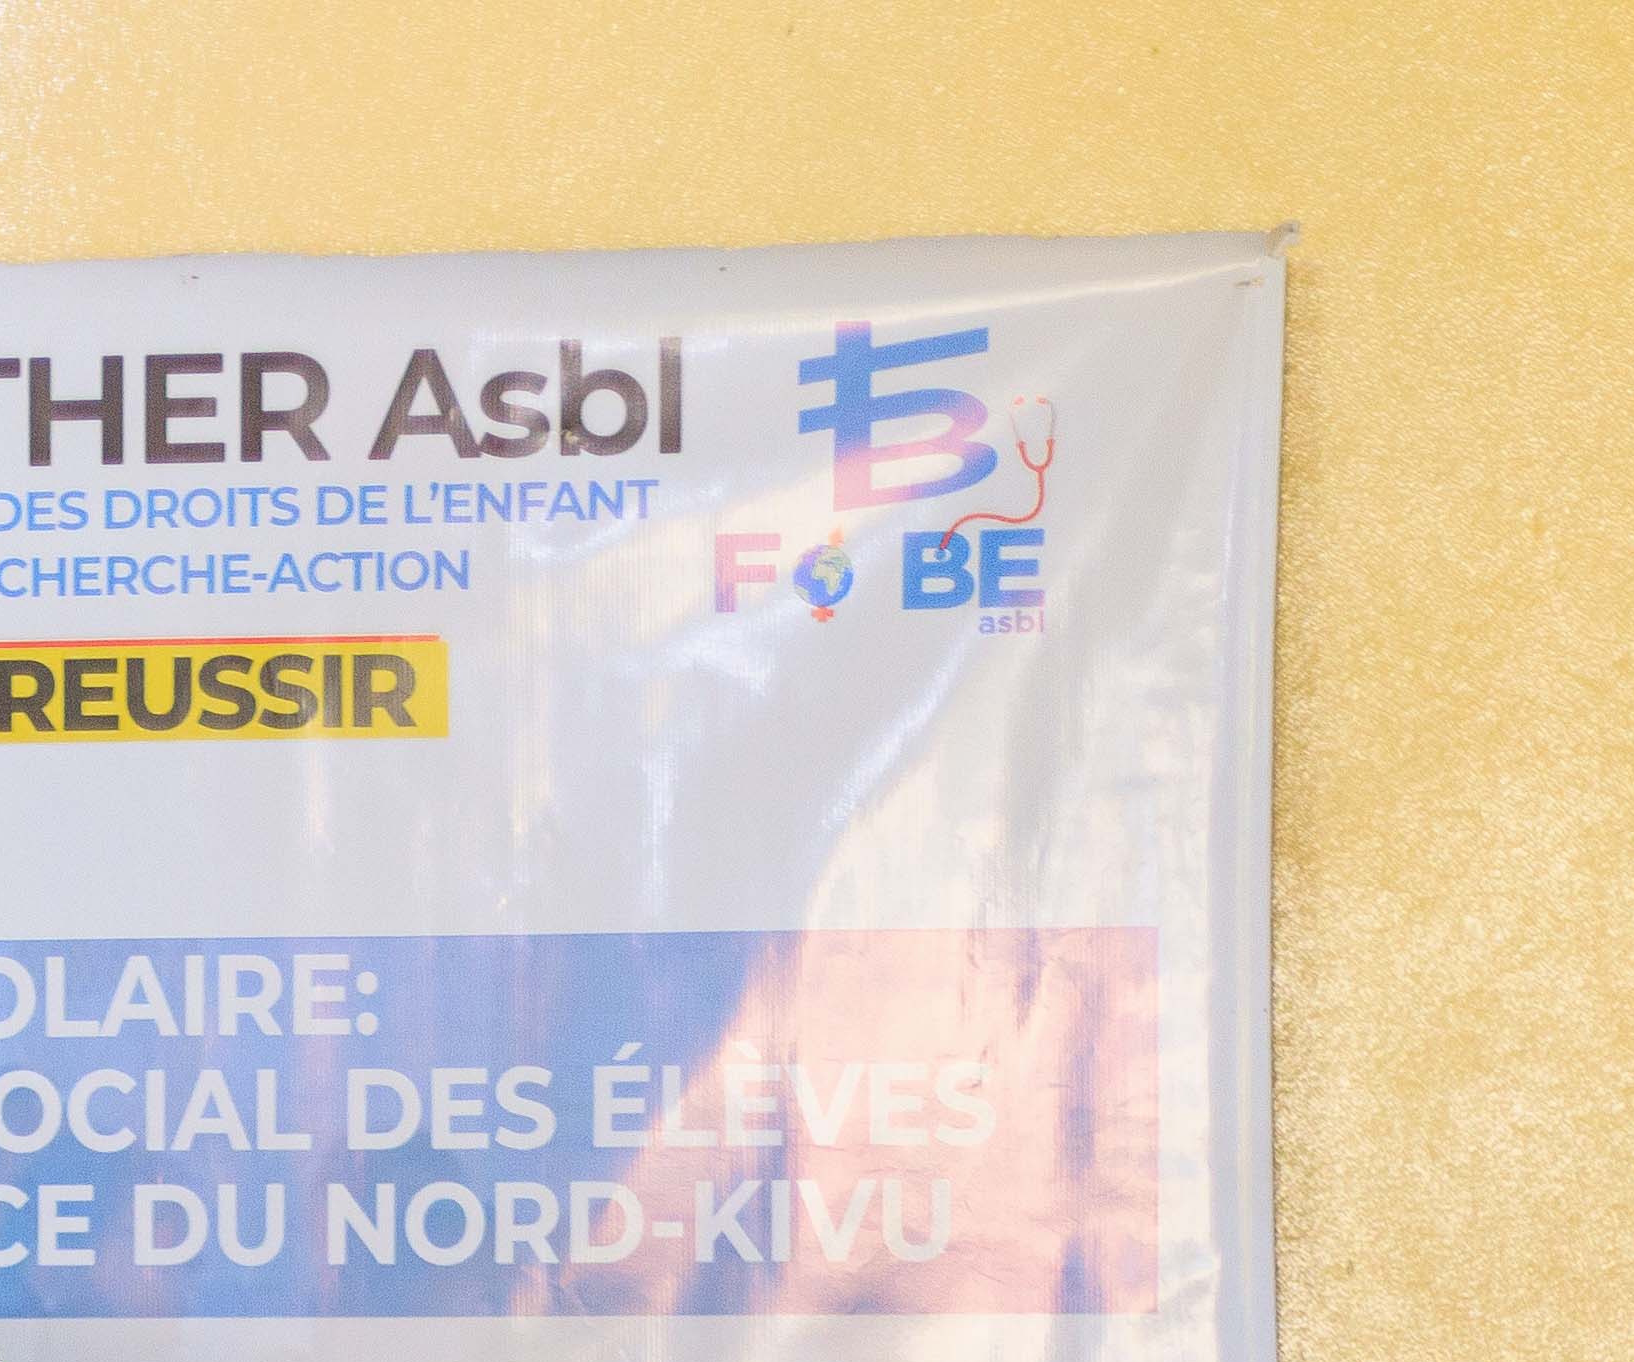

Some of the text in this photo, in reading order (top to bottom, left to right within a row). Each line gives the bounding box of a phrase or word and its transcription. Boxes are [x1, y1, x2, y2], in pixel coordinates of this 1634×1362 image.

[368, 339, 683, 462] Asbl
[103, 485, 302, 529] DROITS
[316, 483, 389, 527] DE
[979, 610, 1045, 635] asbl
[346, 1065, 557, 1152] DES
[592, 1042, 998, 1150] ÉLÈVES
[134, 1182, 286, 1267] DU
[327, 1177, 953, 1267] NORD-KIVU
